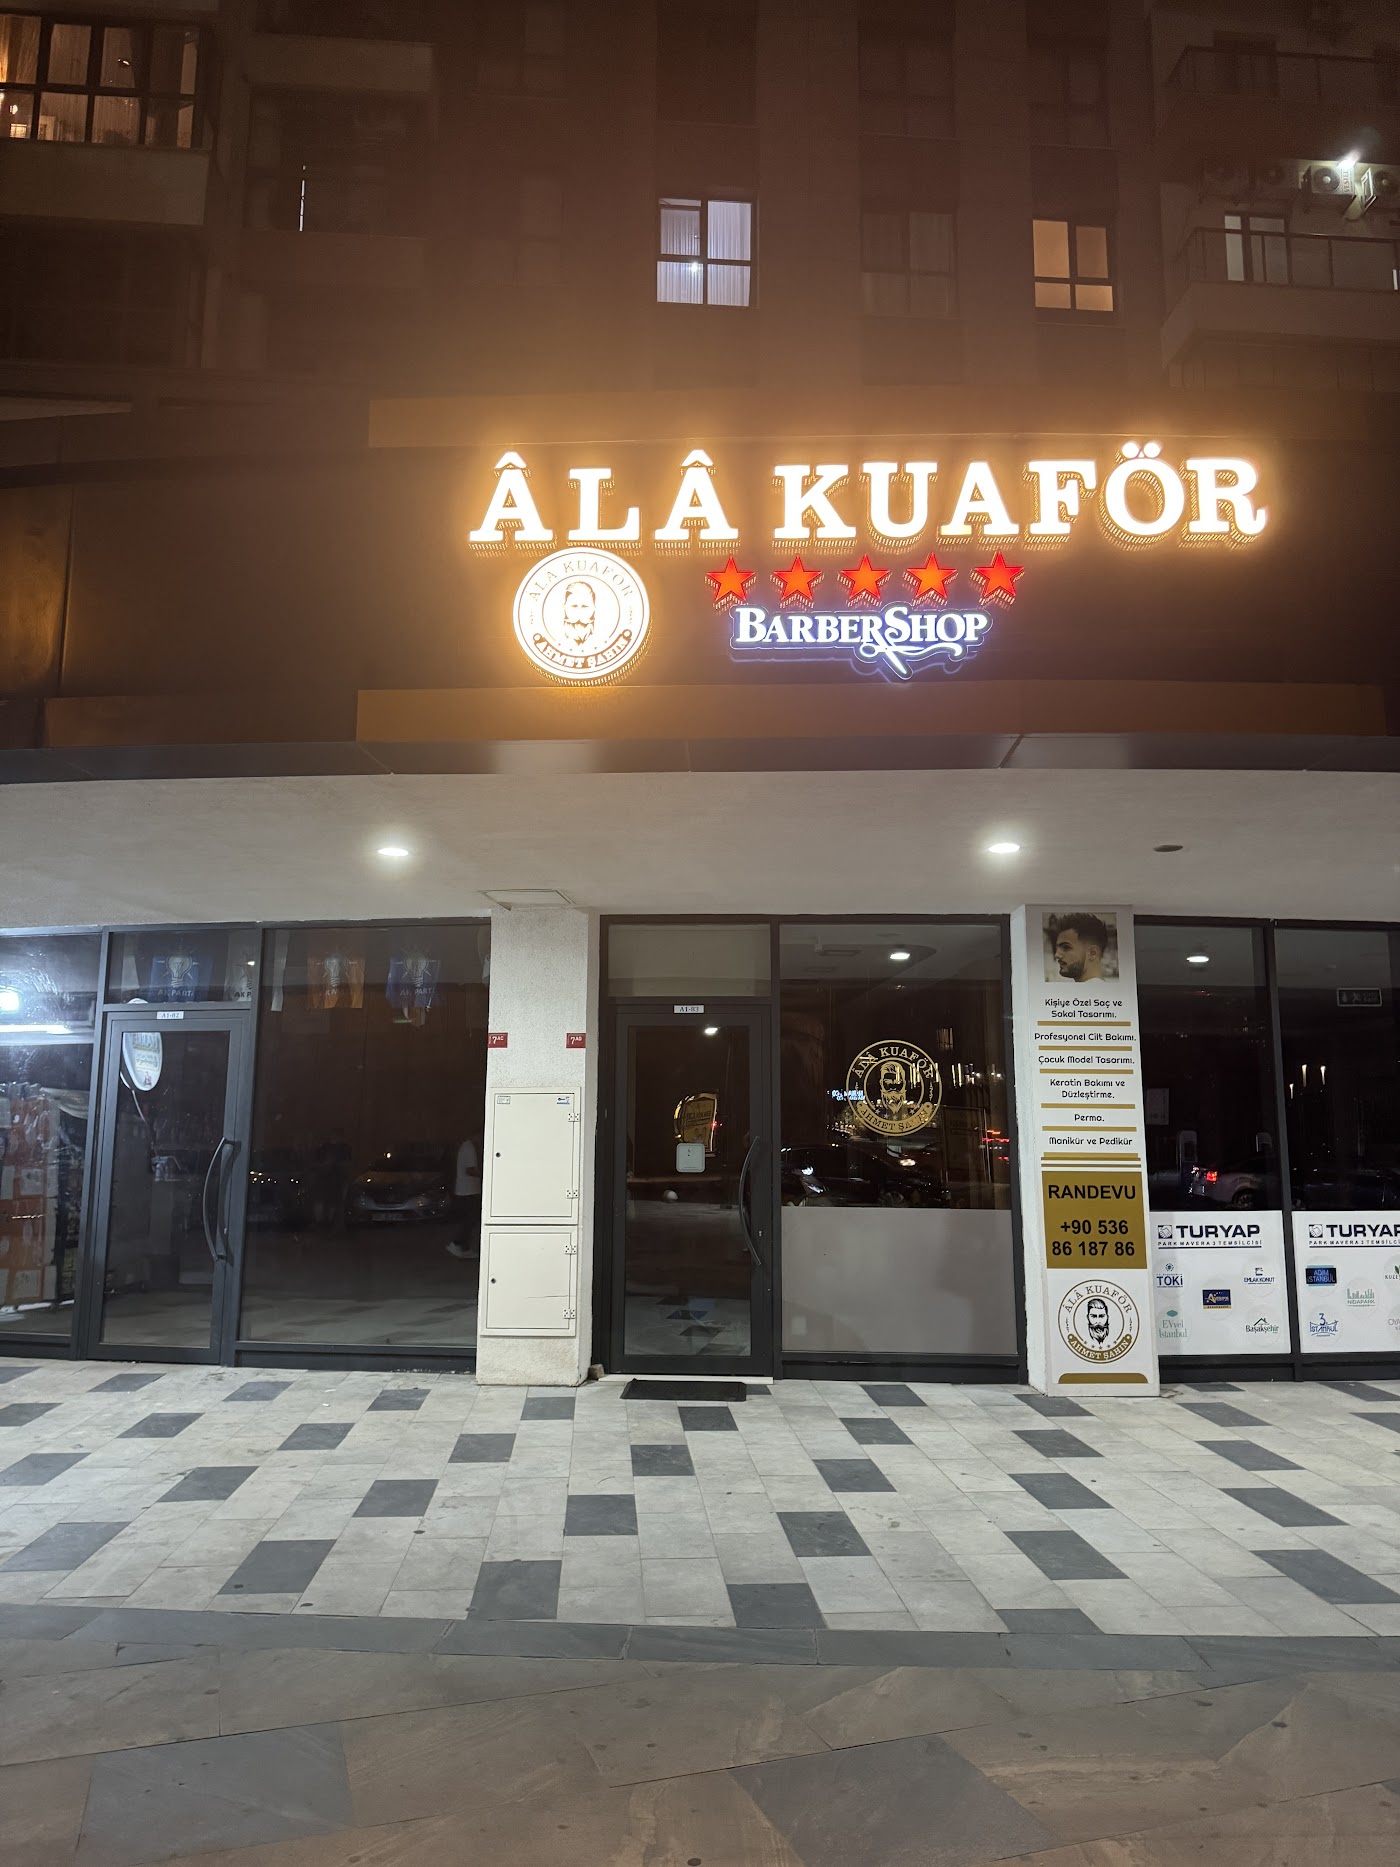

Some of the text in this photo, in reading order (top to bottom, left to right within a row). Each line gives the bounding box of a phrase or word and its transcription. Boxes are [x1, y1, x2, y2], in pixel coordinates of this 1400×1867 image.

[469, 440, 1268, 542] ÂLÂ KUAFÖR
[1044, 998, 1071, 1008] Kişiye
[1072, 997, 1092, 1007] Özel
[1093, 998, 1110, 1009] Saç
[1051, 1010, 1117, 1018] Sakal Tasarımı.
[1034, 1032, 1137, 1043] Profesyonel Cilt Bakımı.
[1038, 1055, 1135, 1065] Çocuk Model Tasarımı.
[1050, 1078, 1082, 1087] Keratin
[1084, 1079, 1113, 1087] Bakımı
[1061, 1089, 1115, 1100] Düzleştirme.
[860, 1109, 896, 1131] AHMET
[1074, 1114, 1105, 1122] Perma.
[1048, 1137, 1084, 1145] Manikür
[1099, 1137, 1133, 1145] Pedikür
[1048, 1184, 1136, 1200] RANDEVU
[1060, 1219, 1129, 1235] +90 536
[1175, 1224, 1260, 1238] TURYAP
[1051, 1241, 1135, 1257] 86 187 86
[1156, 1275, 1184, 1286] TOKİ
[1085, 1285, 1133, 1314] KUAFÖR
[1245, 1324, 1279, 1333] Başakşehir
[1070, 1340, 1102, 1360] AHMET
